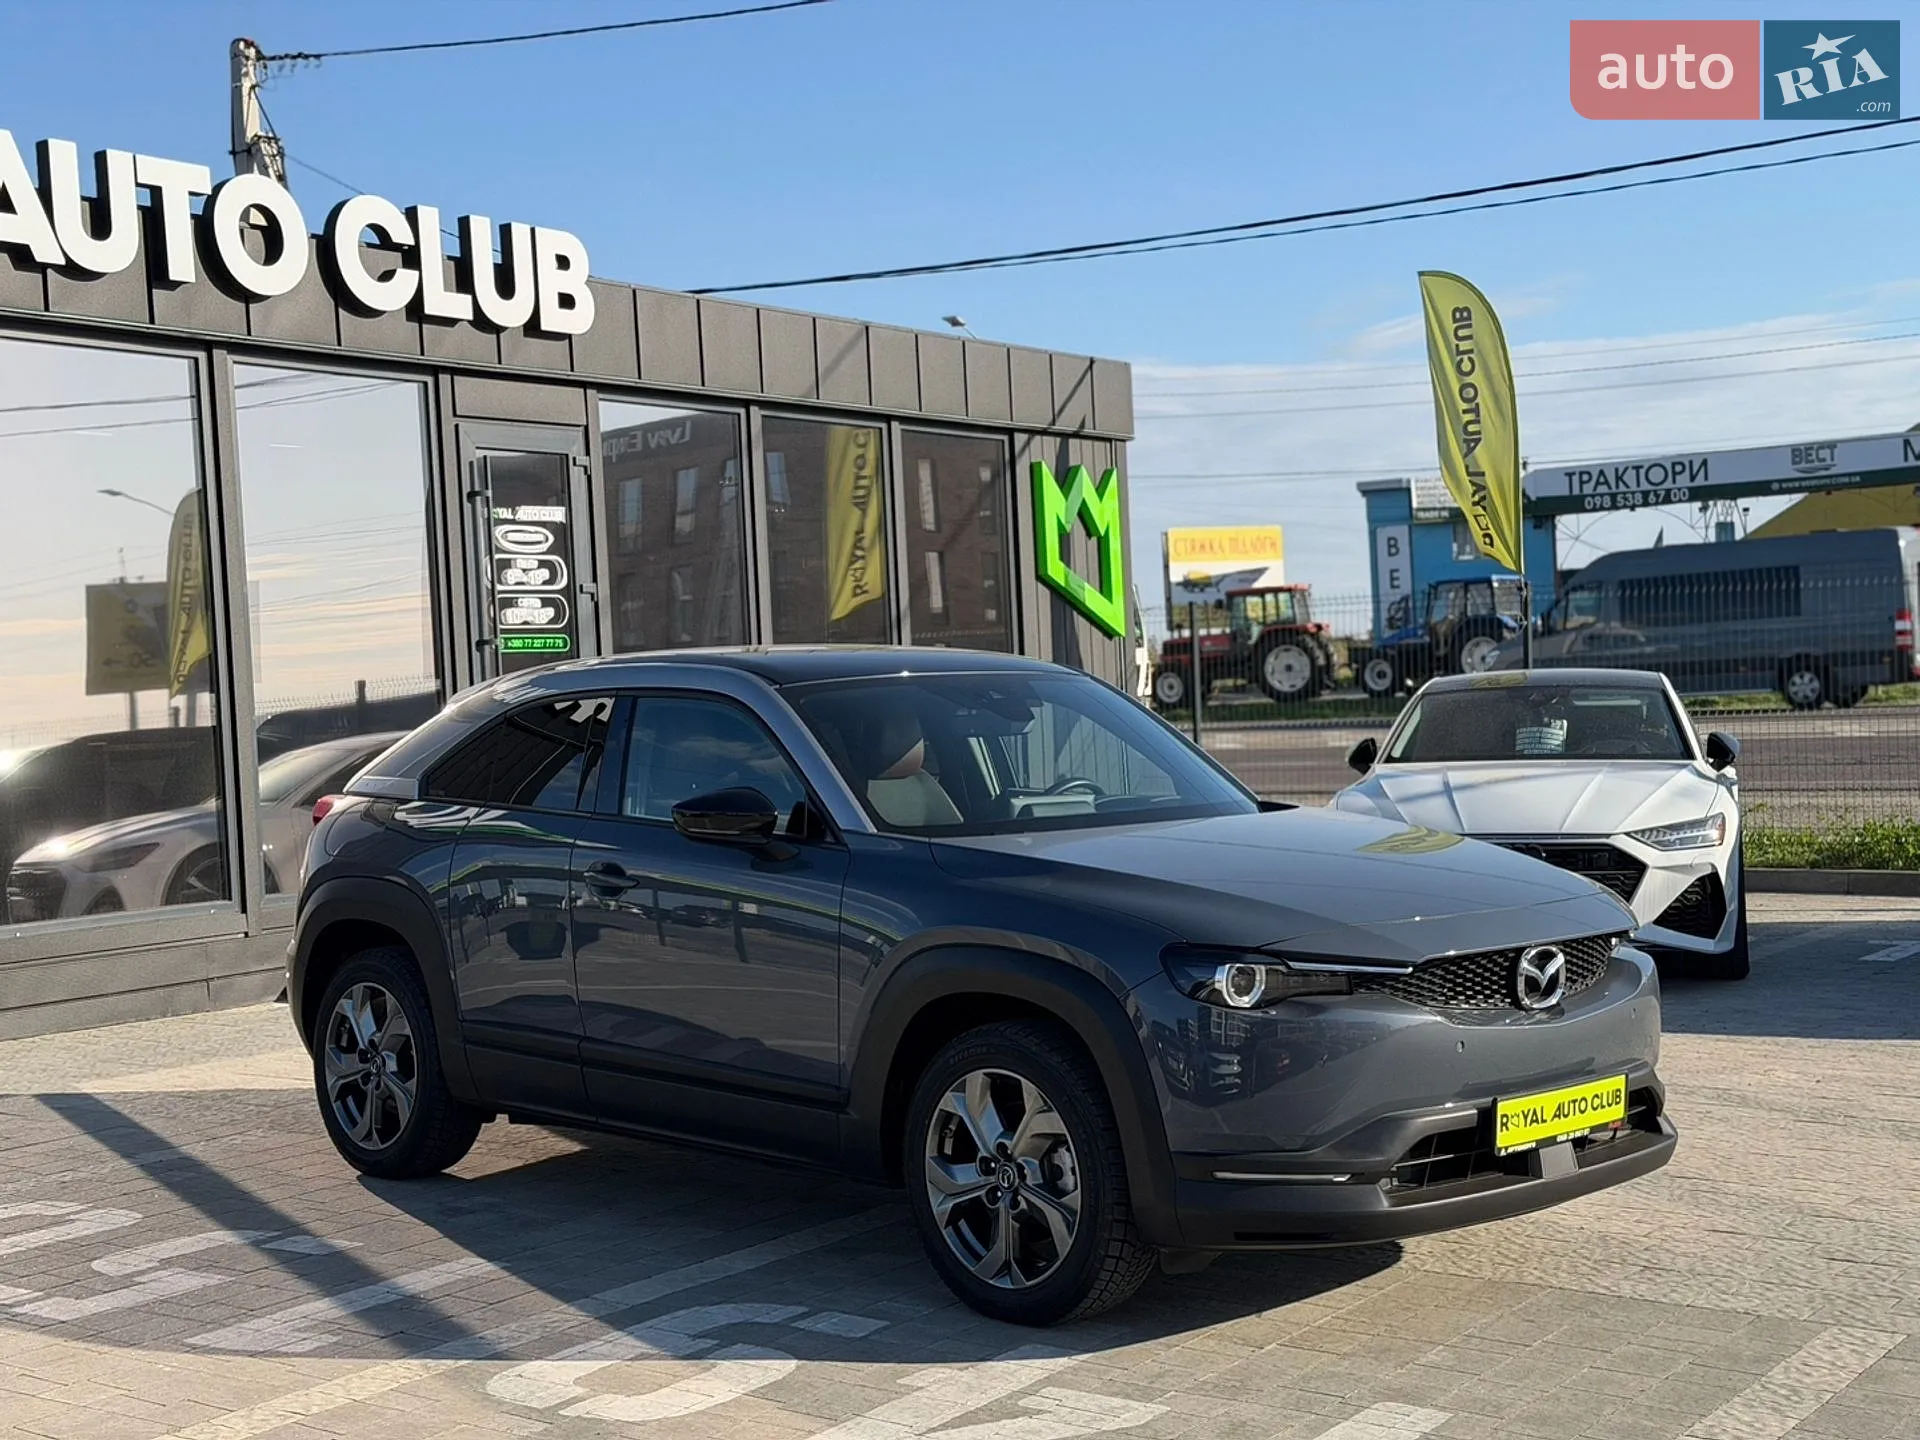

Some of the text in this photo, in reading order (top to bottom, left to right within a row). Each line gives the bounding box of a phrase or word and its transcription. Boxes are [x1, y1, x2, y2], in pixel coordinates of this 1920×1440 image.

[0, 128, 595, 335] AUTO CLUB
[1790, 443, 1837, 466] ВЕСТ
[1564, 458, 1710, 496] ТРАКТОРИ
[1584, 488, 1690, 510] 098 538 67 00
[1551, 1096, 1589, 1121] AUTO
[1590, 1087, 1622, 1109] CLUB
